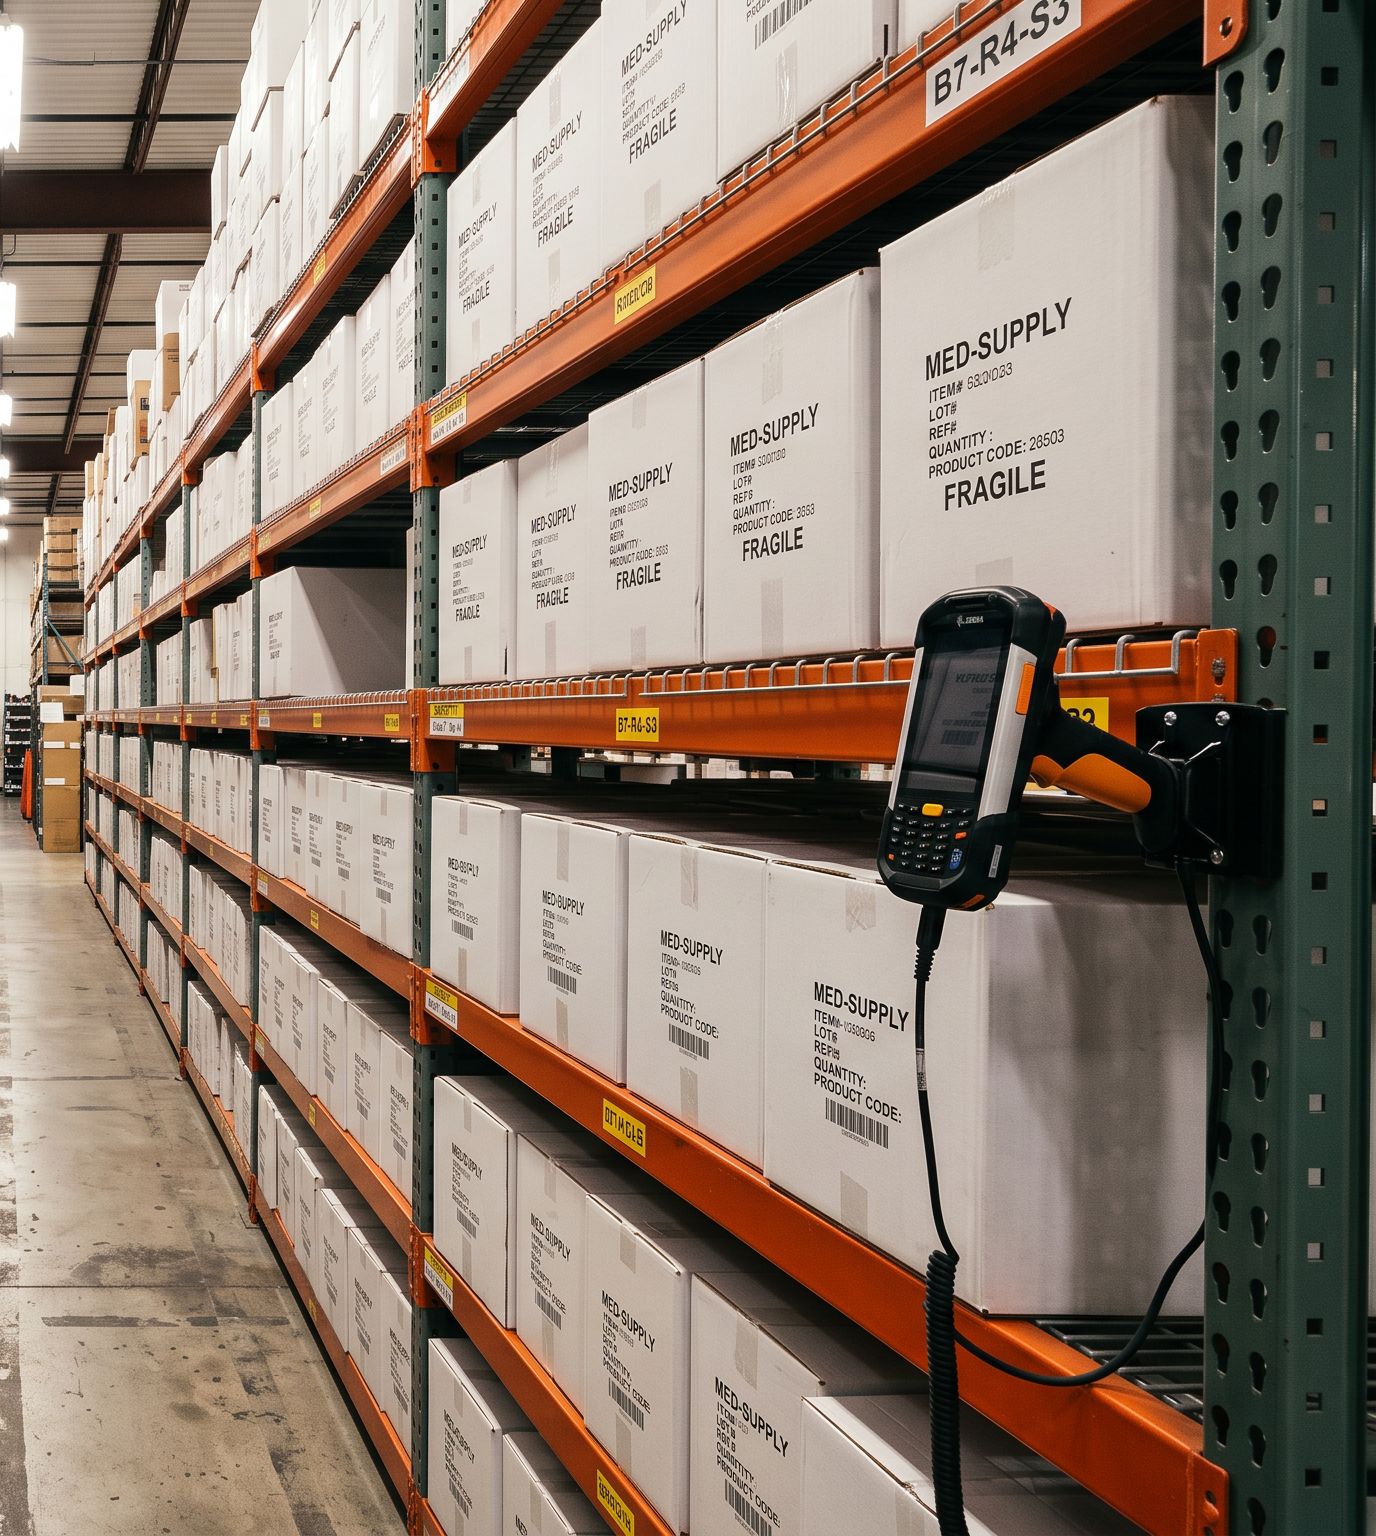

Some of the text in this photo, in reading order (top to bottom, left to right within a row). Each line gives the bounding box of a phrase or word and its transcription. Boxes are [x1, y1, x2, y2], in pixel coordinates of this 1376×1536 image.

[935, 0, 1070, 107] B7-R4-S3
[630, 108, 677, 164] FRAGILE
[538, 205, 574, 248] FRAGILE
[926, 297, 1072, 381] MED-SUPPLY
[730, 403, 819, 457] MED-SUPPLY
[608, 462, 673, 502] MED-SUPPLY
[929, 452, 984, 479] PRODUCT
[986, 439, 1026, 463] CODE:
[944, 459, 1046, 511] FRAGILE
[532, 504, 576, 534] MED-SUPPLY
[743, 526, 804, 562] FRAGILE
[536, 586, 569, 610] FRAGILE
[616, 562, 662, 591] FRAGILE
[660, 930, 723, 966] MED-SUPPLY
[814, 982, 909, 1032] MED-SUPPLY
[814, 1056, 866, 1090] QUANTITY:
[814, 1072, 902, 1124] PRODUCT CODE:
[602, 1290, 655, 1353] MED-SUPPLY
[715, 1376, 789, 1458] MED-SUPPLY
